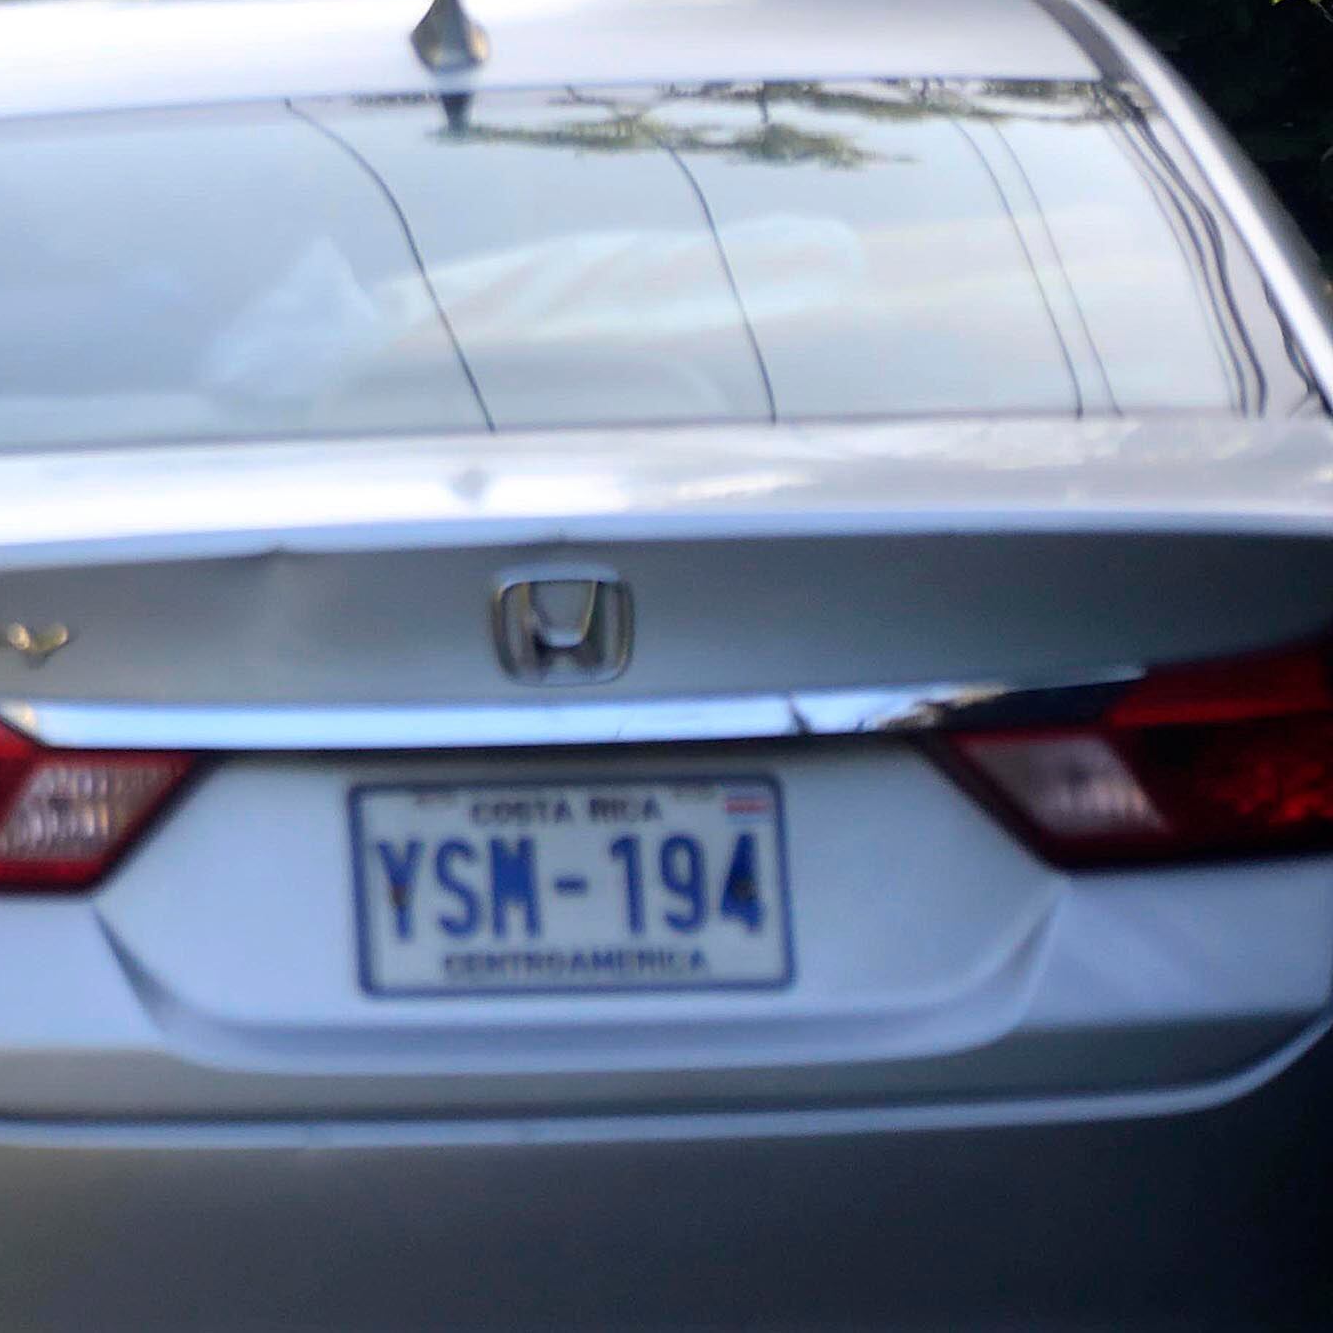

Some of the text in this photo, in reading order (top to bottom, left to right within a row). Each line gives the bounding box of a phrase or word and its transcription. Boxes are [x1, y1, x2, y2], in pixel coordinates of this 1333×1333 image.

[470, 796, 663, 825] COSTA RICA
[375, 831, 765, 942] YSM-194
